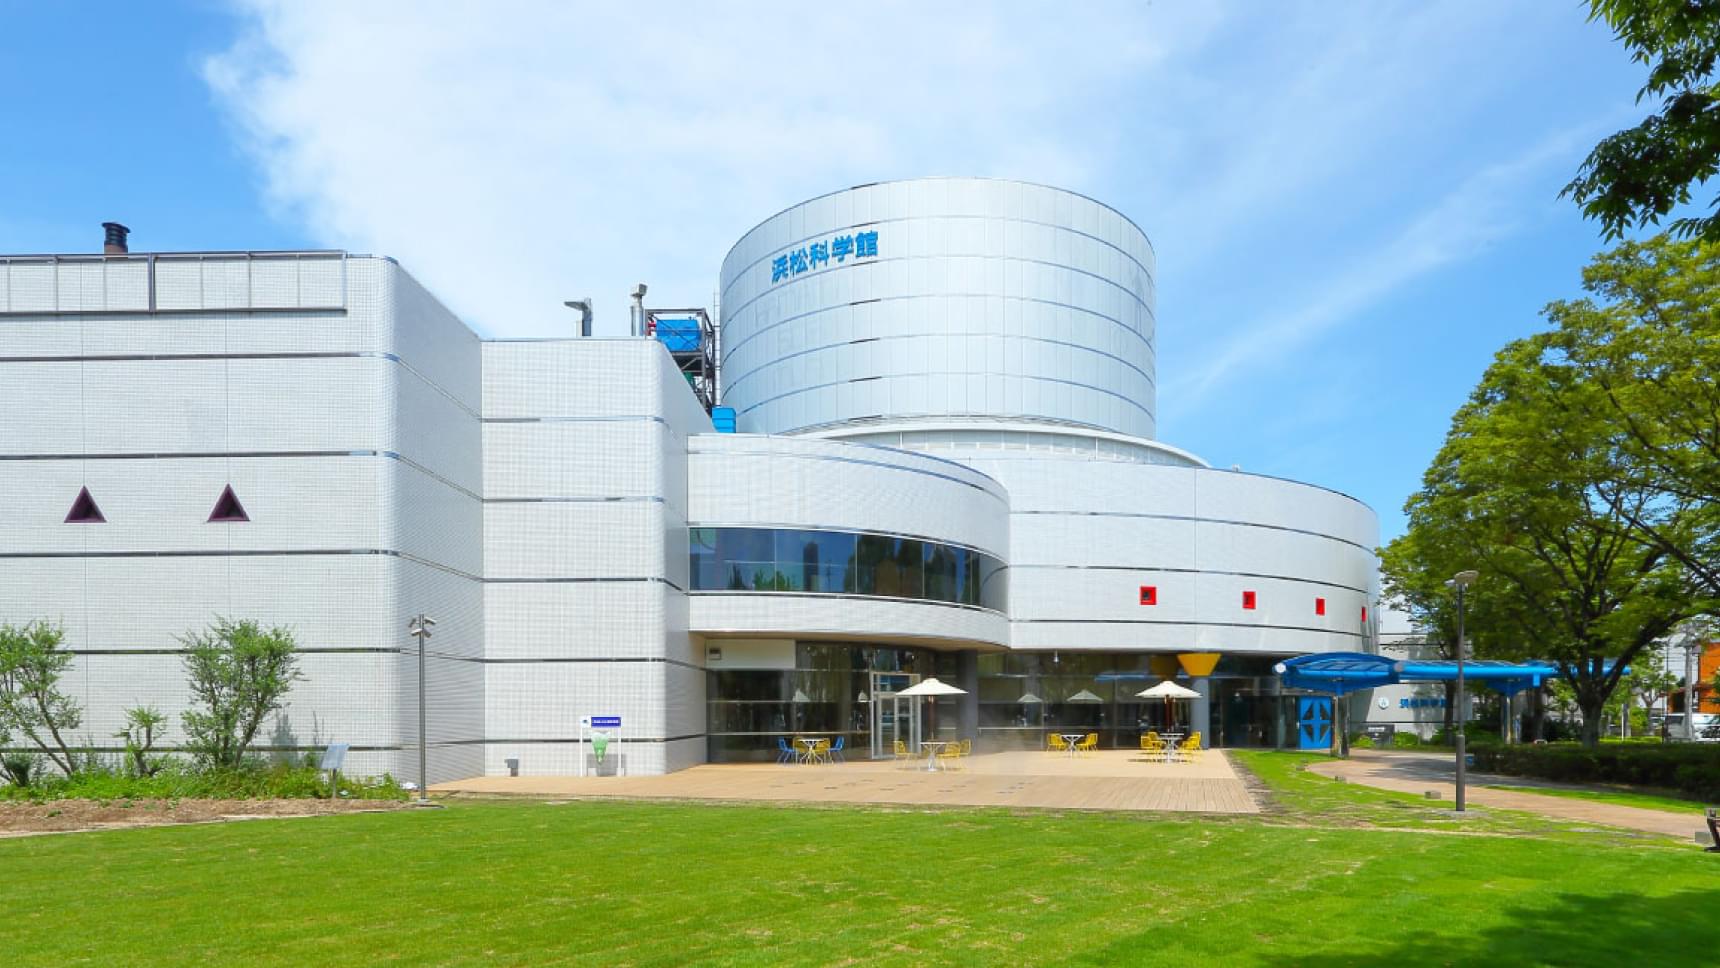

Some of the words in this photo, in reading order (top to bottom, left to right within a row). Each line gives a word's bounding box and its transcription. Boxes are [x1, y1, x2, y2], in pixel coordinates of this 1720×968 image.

[772, 230, 879, 283] 浜松科学館
